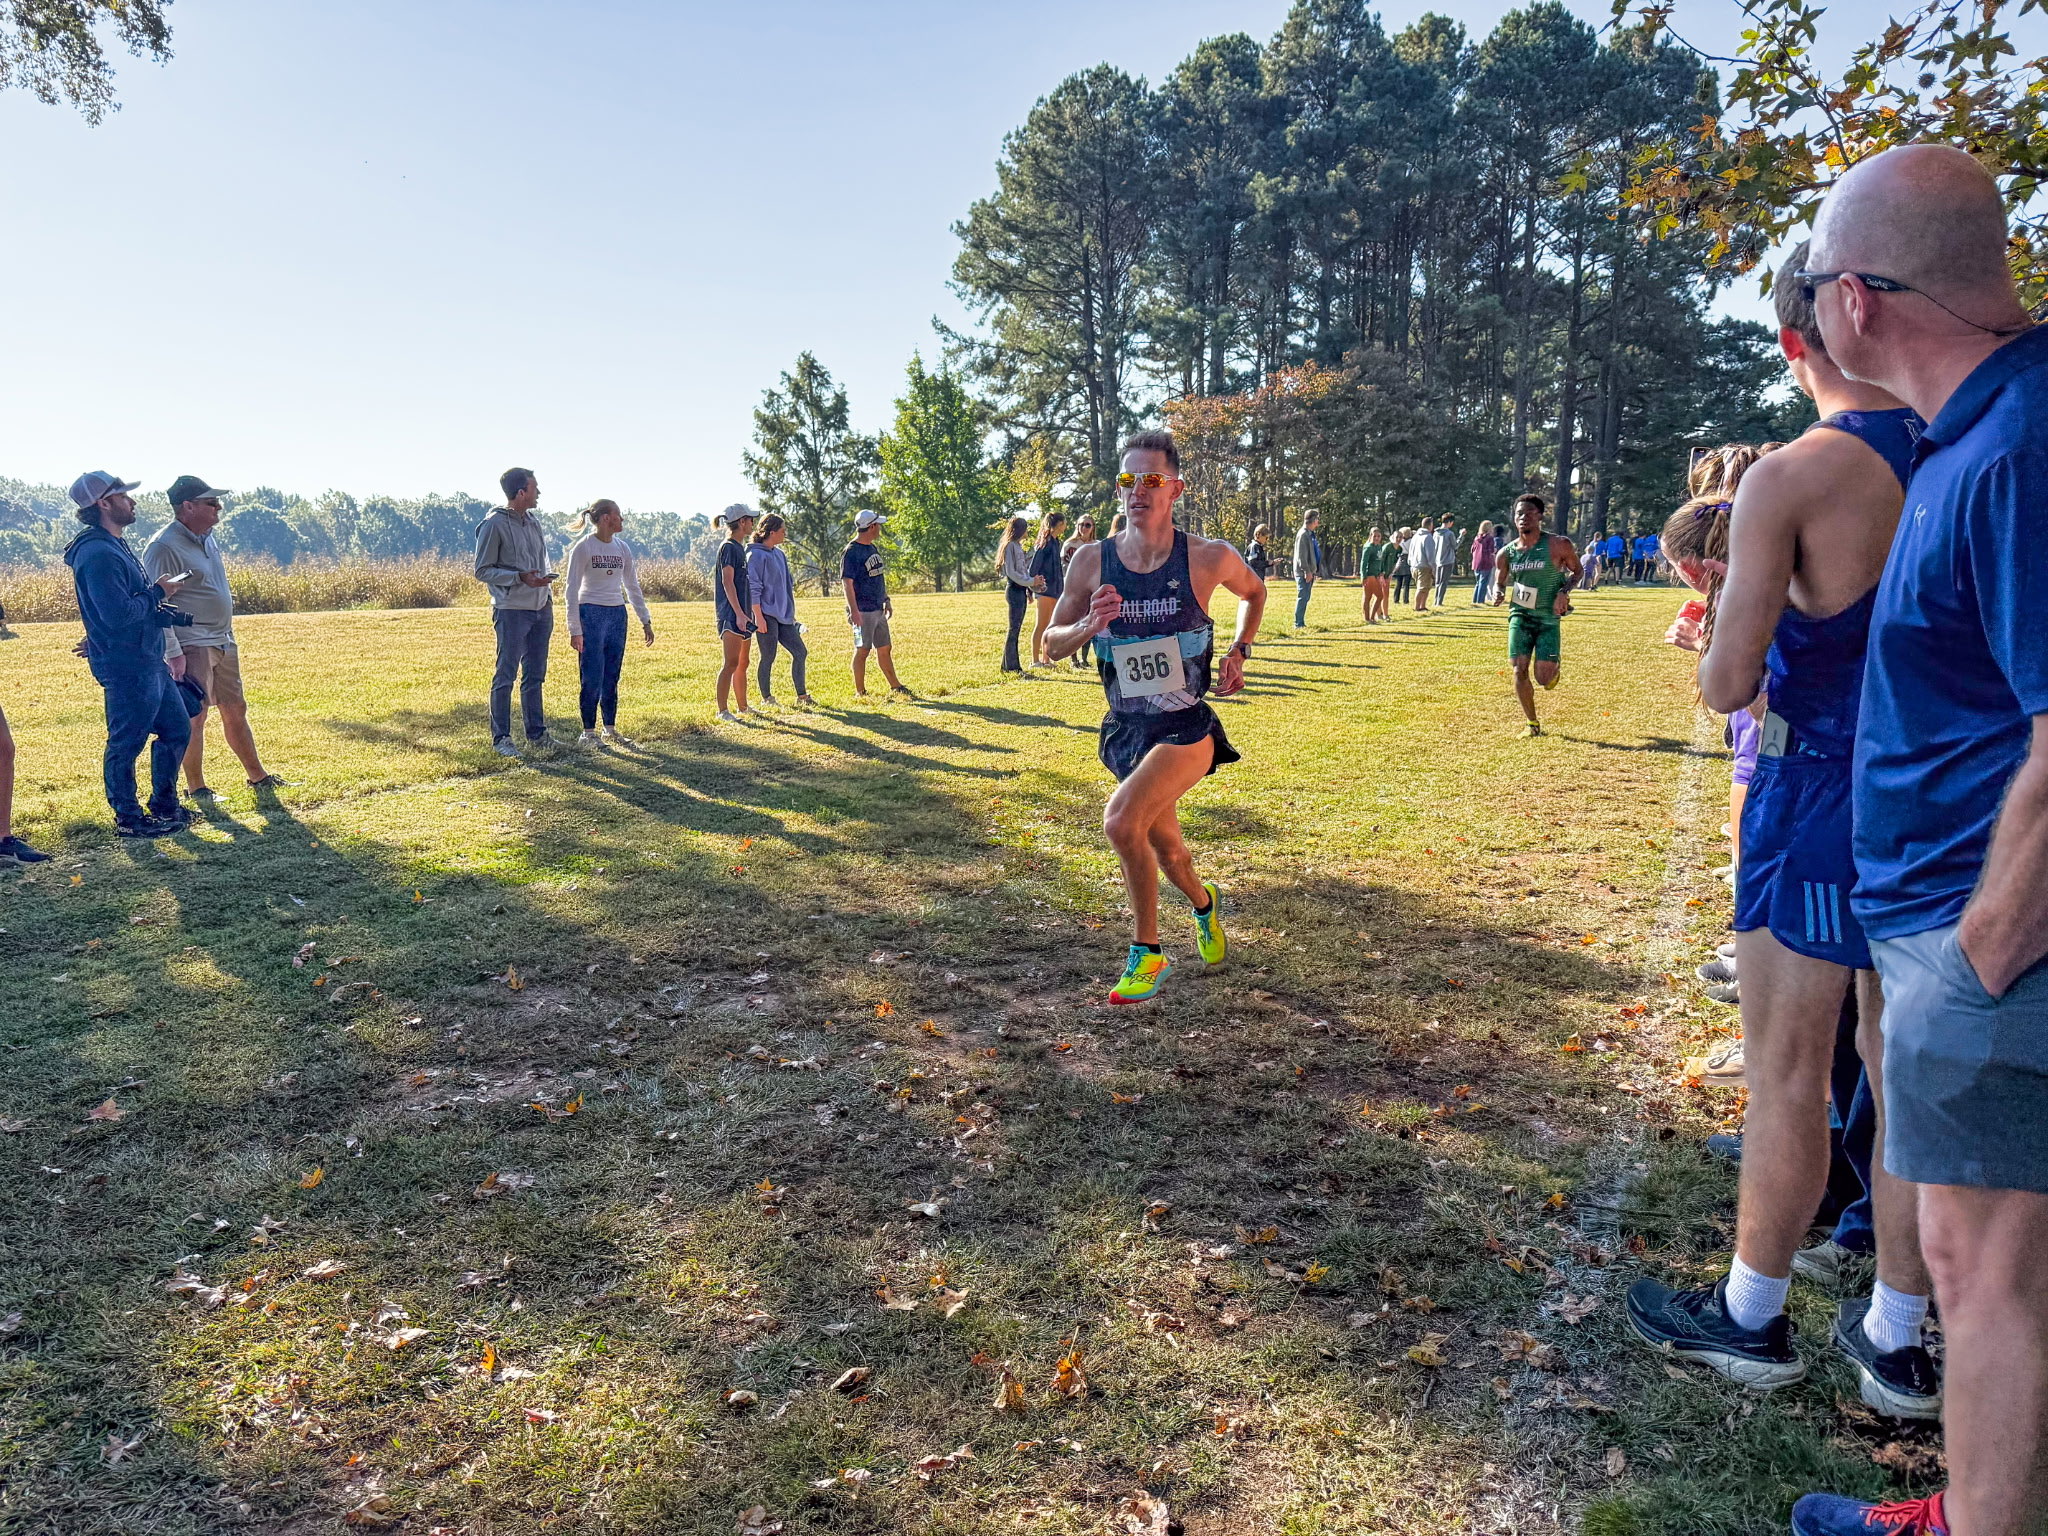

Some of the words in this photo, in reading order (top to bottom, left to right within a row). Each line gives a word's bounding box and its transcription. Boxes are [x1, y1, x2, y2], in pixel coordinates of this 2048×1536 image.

[1511, 560, 1545, 571] Upstate
[1123, 616, 1166, 624] ATHLETICS
[1126, 652, 1170, 683] 356
